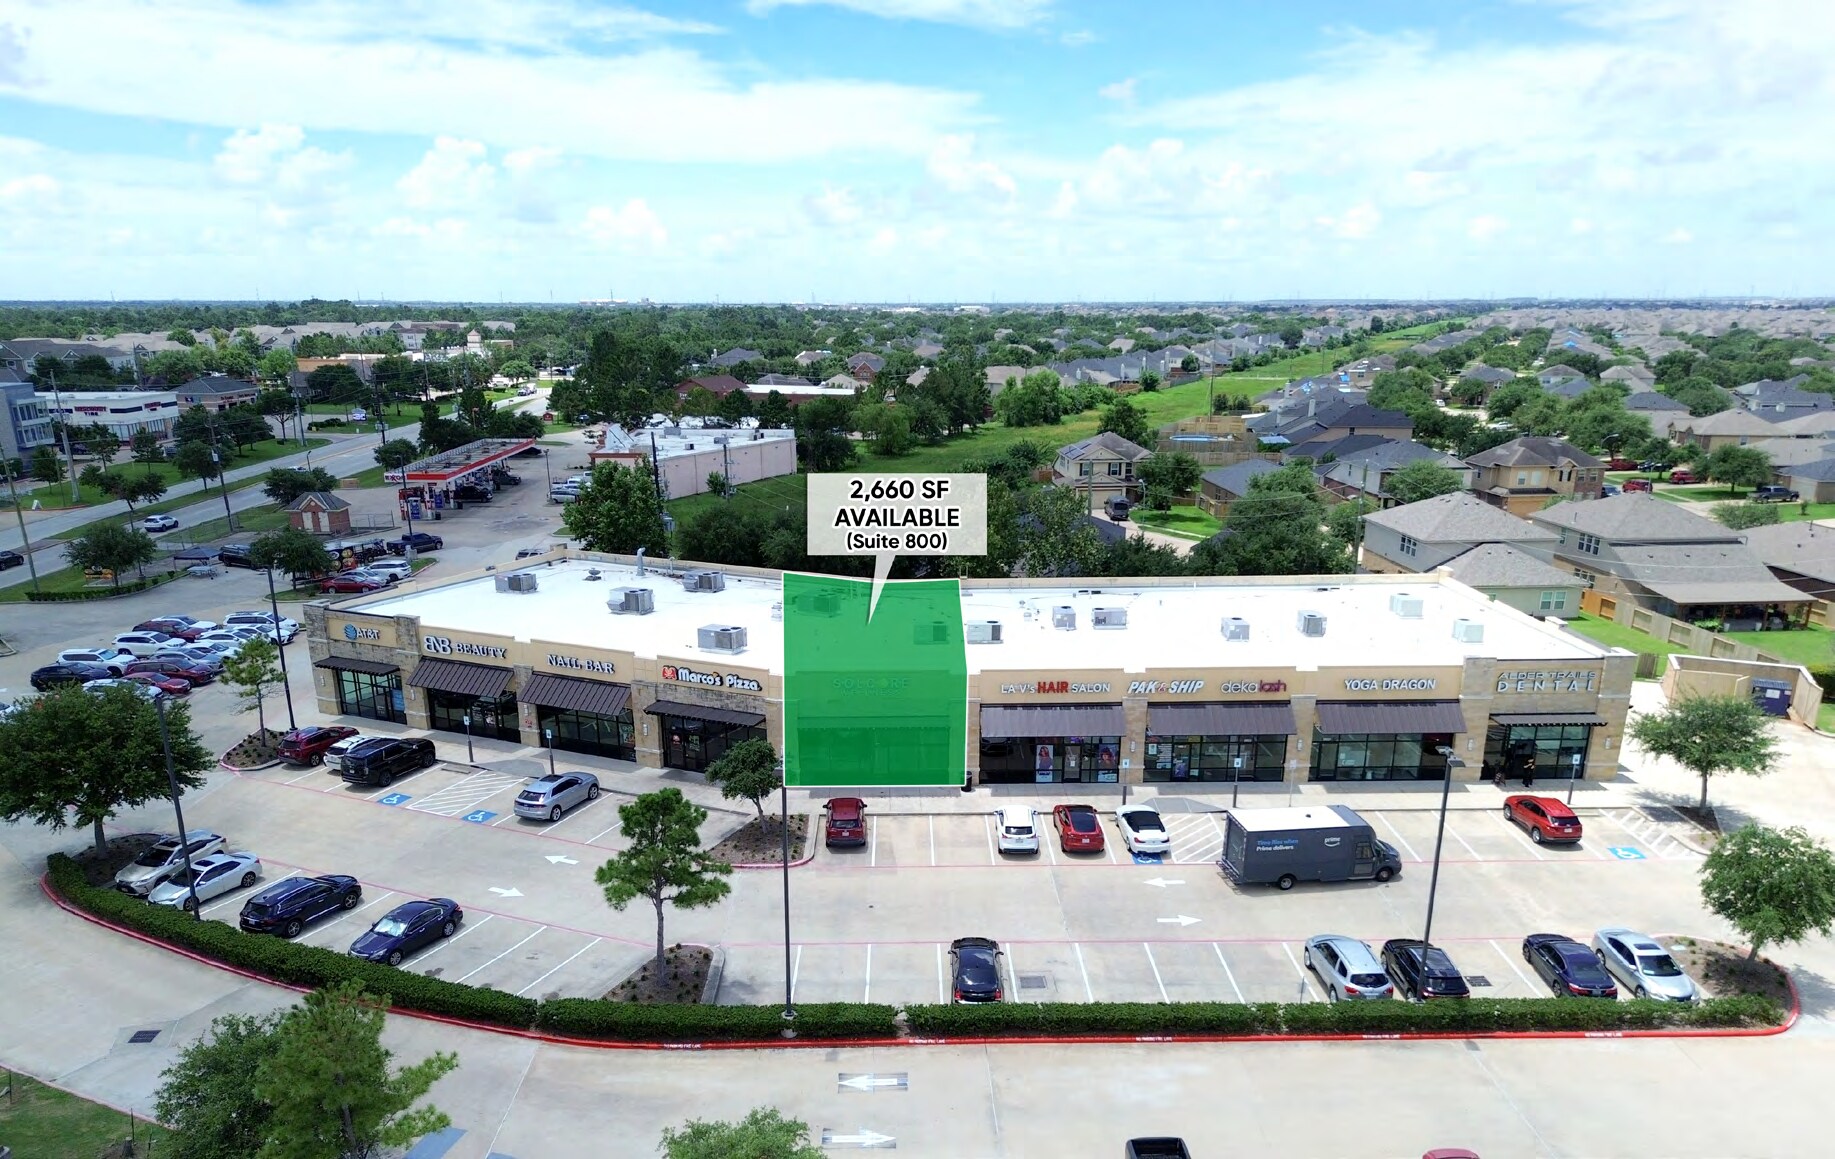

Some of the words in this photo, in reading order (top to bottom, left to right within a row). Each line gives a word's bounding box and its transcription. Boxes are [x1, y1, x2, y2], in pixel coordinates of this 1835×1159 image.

[356, 627, 380, 640] AT&T
[455, 643, 507, 659] BEAUTY
[547, 654, 582, 670] NAIL
[585, 660, 615, 674] BAR
[677, 667, 723, 686] Marco's
[1498, 672, 1544, 680] ALDER
[1548, 671, 1597, 679] TRAILS
[1001, 684, 1016, 694] LA
[1037, 681, 1069, 694] HAIR
[1071, 683, 1111, 694] SALON
[1127, 681, 1158, 694] PAK
[1168, 680, 1204, 694] SHIP
[1221, 680, 1258, 694] deka
[1259, 680, 1287, 693] lash
[1344, 679, 1378, 691] YOGA
[1382, 678, 1436, 690] DRAGON
[1496, 680, 1595, 693] DENTAL
